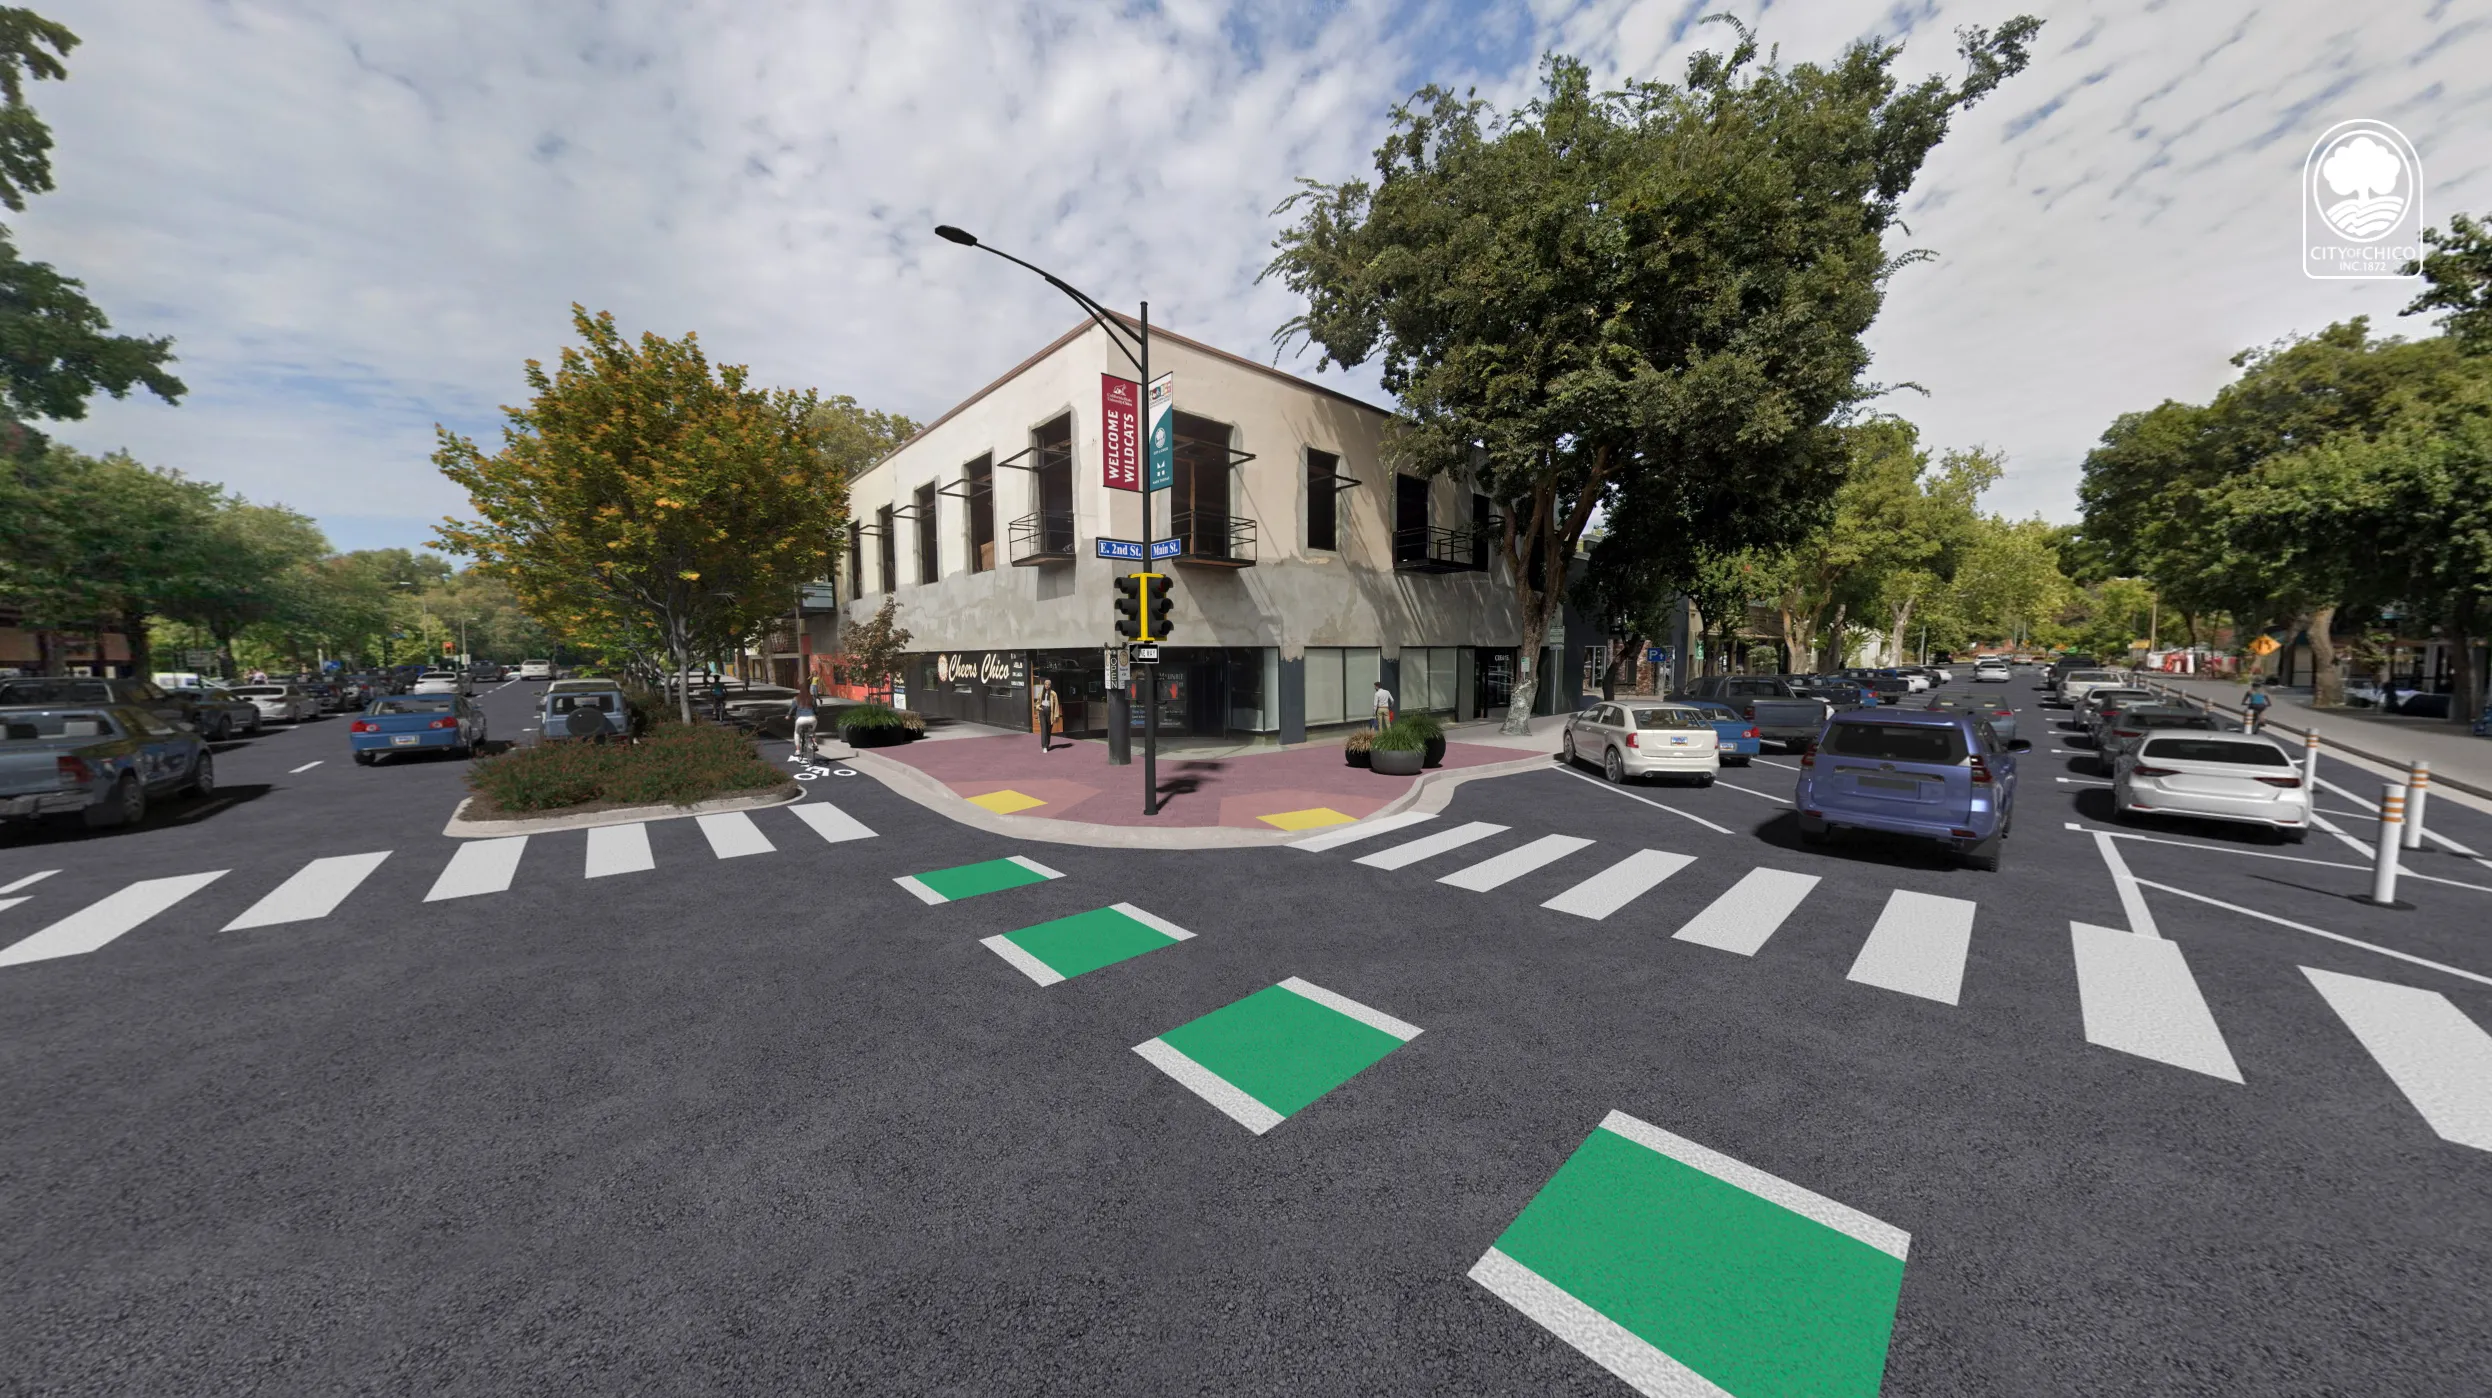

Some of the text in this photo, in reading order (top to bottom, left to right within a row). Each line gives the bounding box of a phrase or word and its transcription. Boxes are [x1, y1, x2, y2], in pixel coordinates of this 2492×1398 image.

[1108, 410, 1119, 479] WELCOME
[1124, 414, 1134, 482] WILDCATS
[1100, 542, 1141, 557] E. 2nd St.
[1153, 542, 1178, 556] Main St.
[948, 654, 978, 682] Cheers
[980, 653, 1010, 684] Chico
